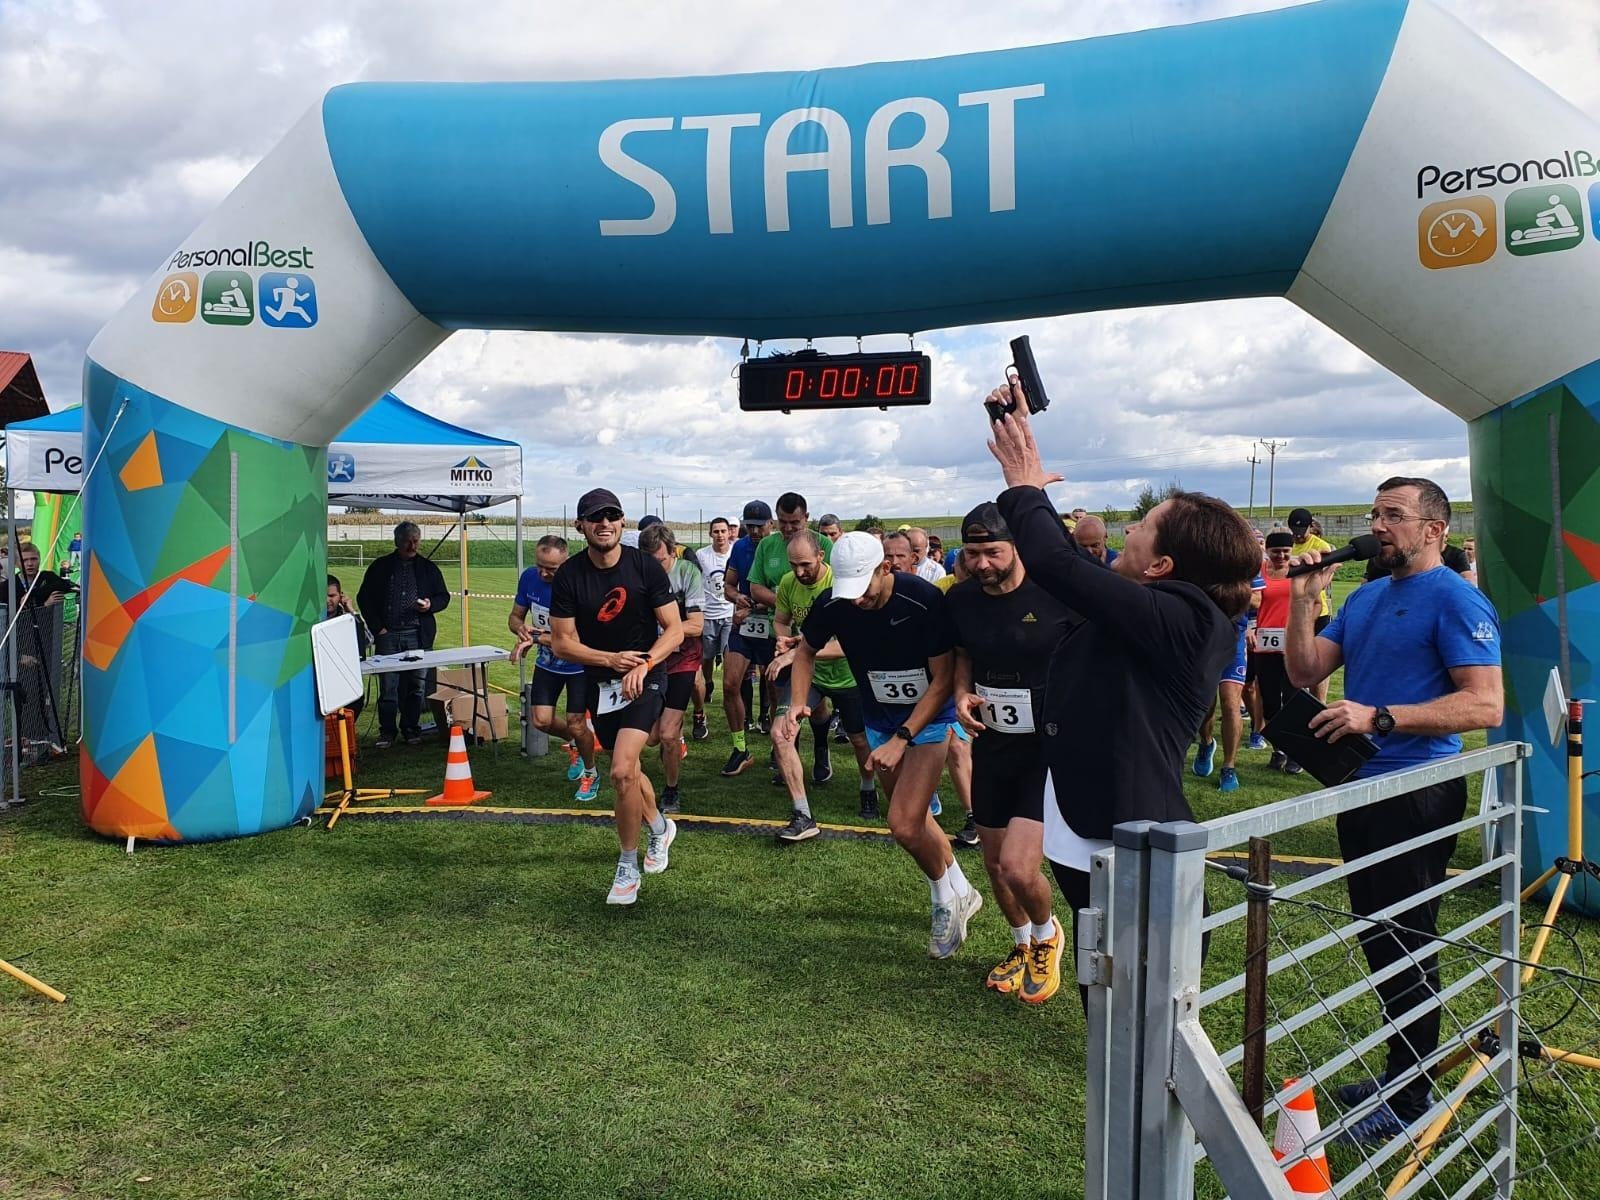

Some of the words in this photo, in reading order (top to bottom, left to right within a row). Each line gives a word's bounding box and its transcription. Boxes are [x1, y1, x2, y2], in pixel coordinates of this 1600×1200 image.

[599, 83, 1045, 236] START
[1417, 150, 1600, 199] PersonalB
[167, 241, 314, 271] PersonalBest
[786, 366, 918, 399] 0:00:00
[450, 469, 493, 482] MITKO
[538, 614, 551, 626] 5
[747, 622, 765, 634] 33
[1262, 636, 1279, 647] 76
[883, 683, 918, 698] 36
[987, 703, 1019, 725] 13
